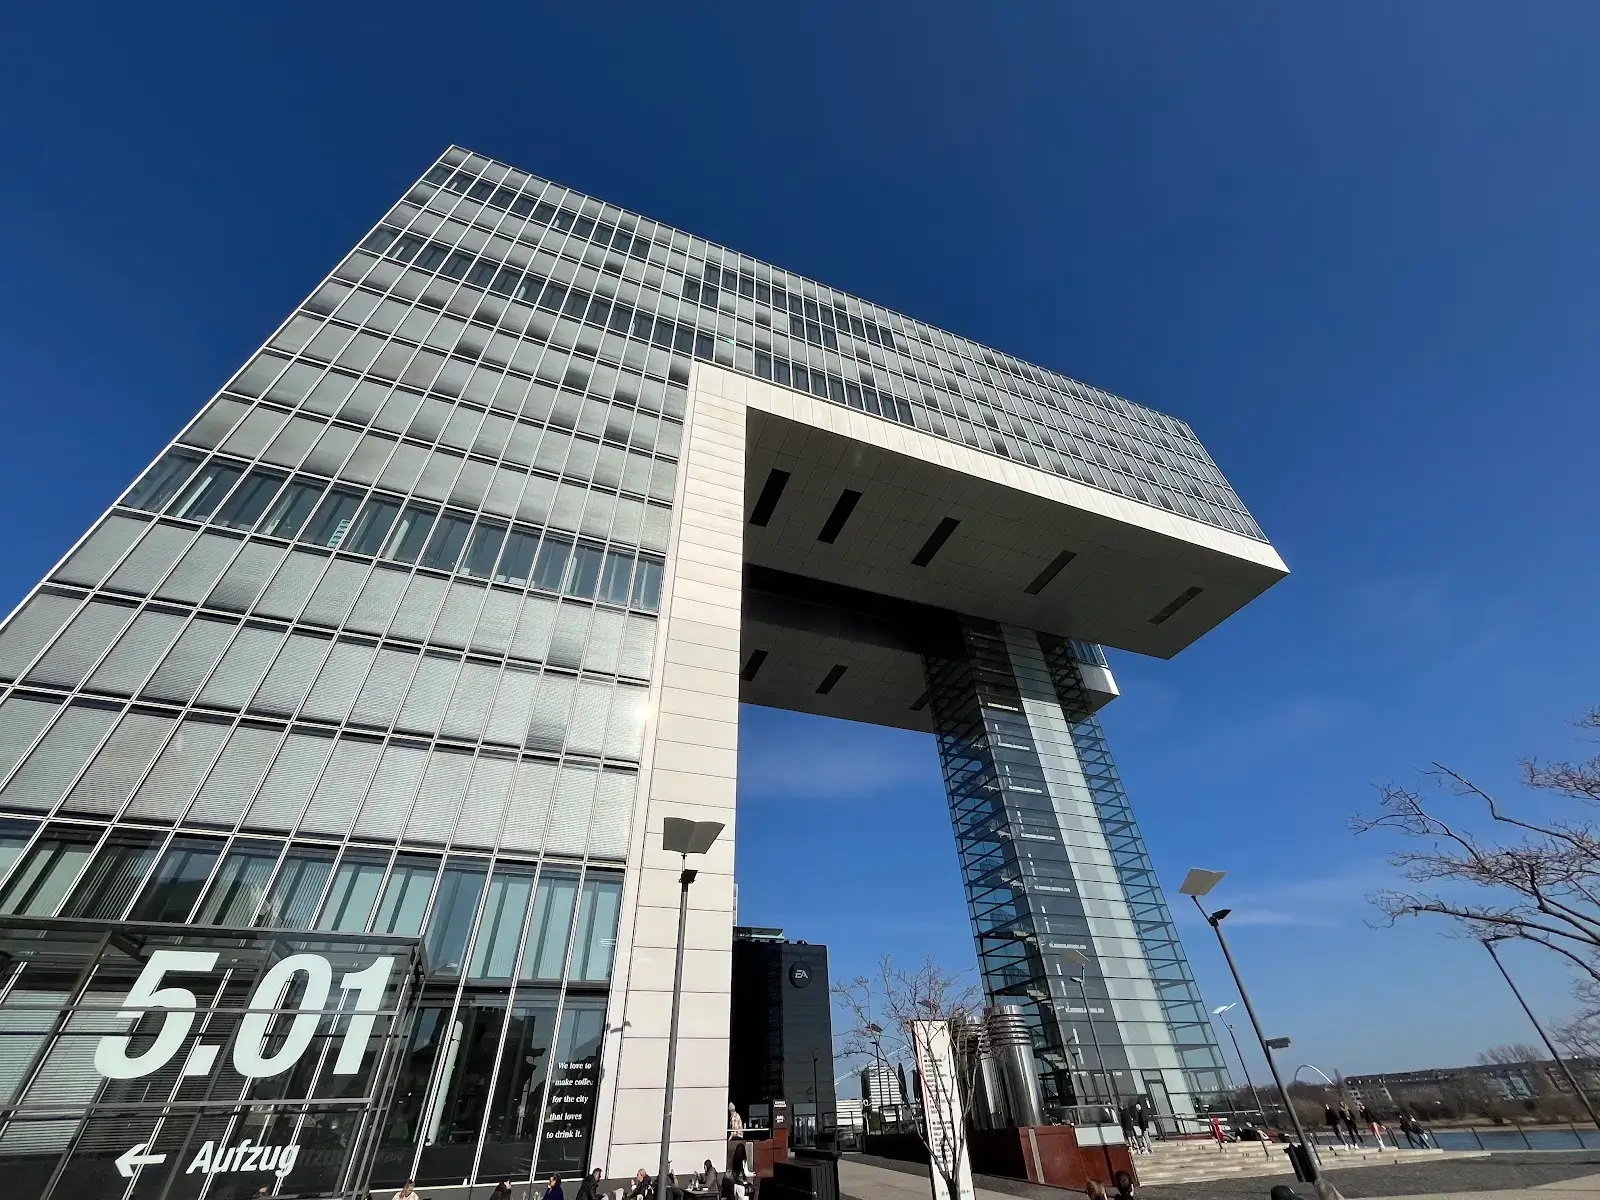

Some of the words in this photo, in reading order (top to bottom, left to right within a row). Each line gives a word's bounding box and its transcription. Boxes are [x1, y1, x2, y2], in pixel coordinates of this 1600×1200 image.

[795, 969, 808, 979] EA
[94, 950, 395, 1079] 5.01
[555, 1078, 573, 1086] make
[552, 1095, 563, 1104] for
[563, 1095, 575, 1103] the
[575, 1095, 589, 1104] city
[549, 1112, 563, 1121] that
[564, 1112, 582, 1120] loves
[546, 1131, 554, 1139] to
[555, 1130, 574, 1138] drink
[186, 1138, 300, 1177] Aufzug
